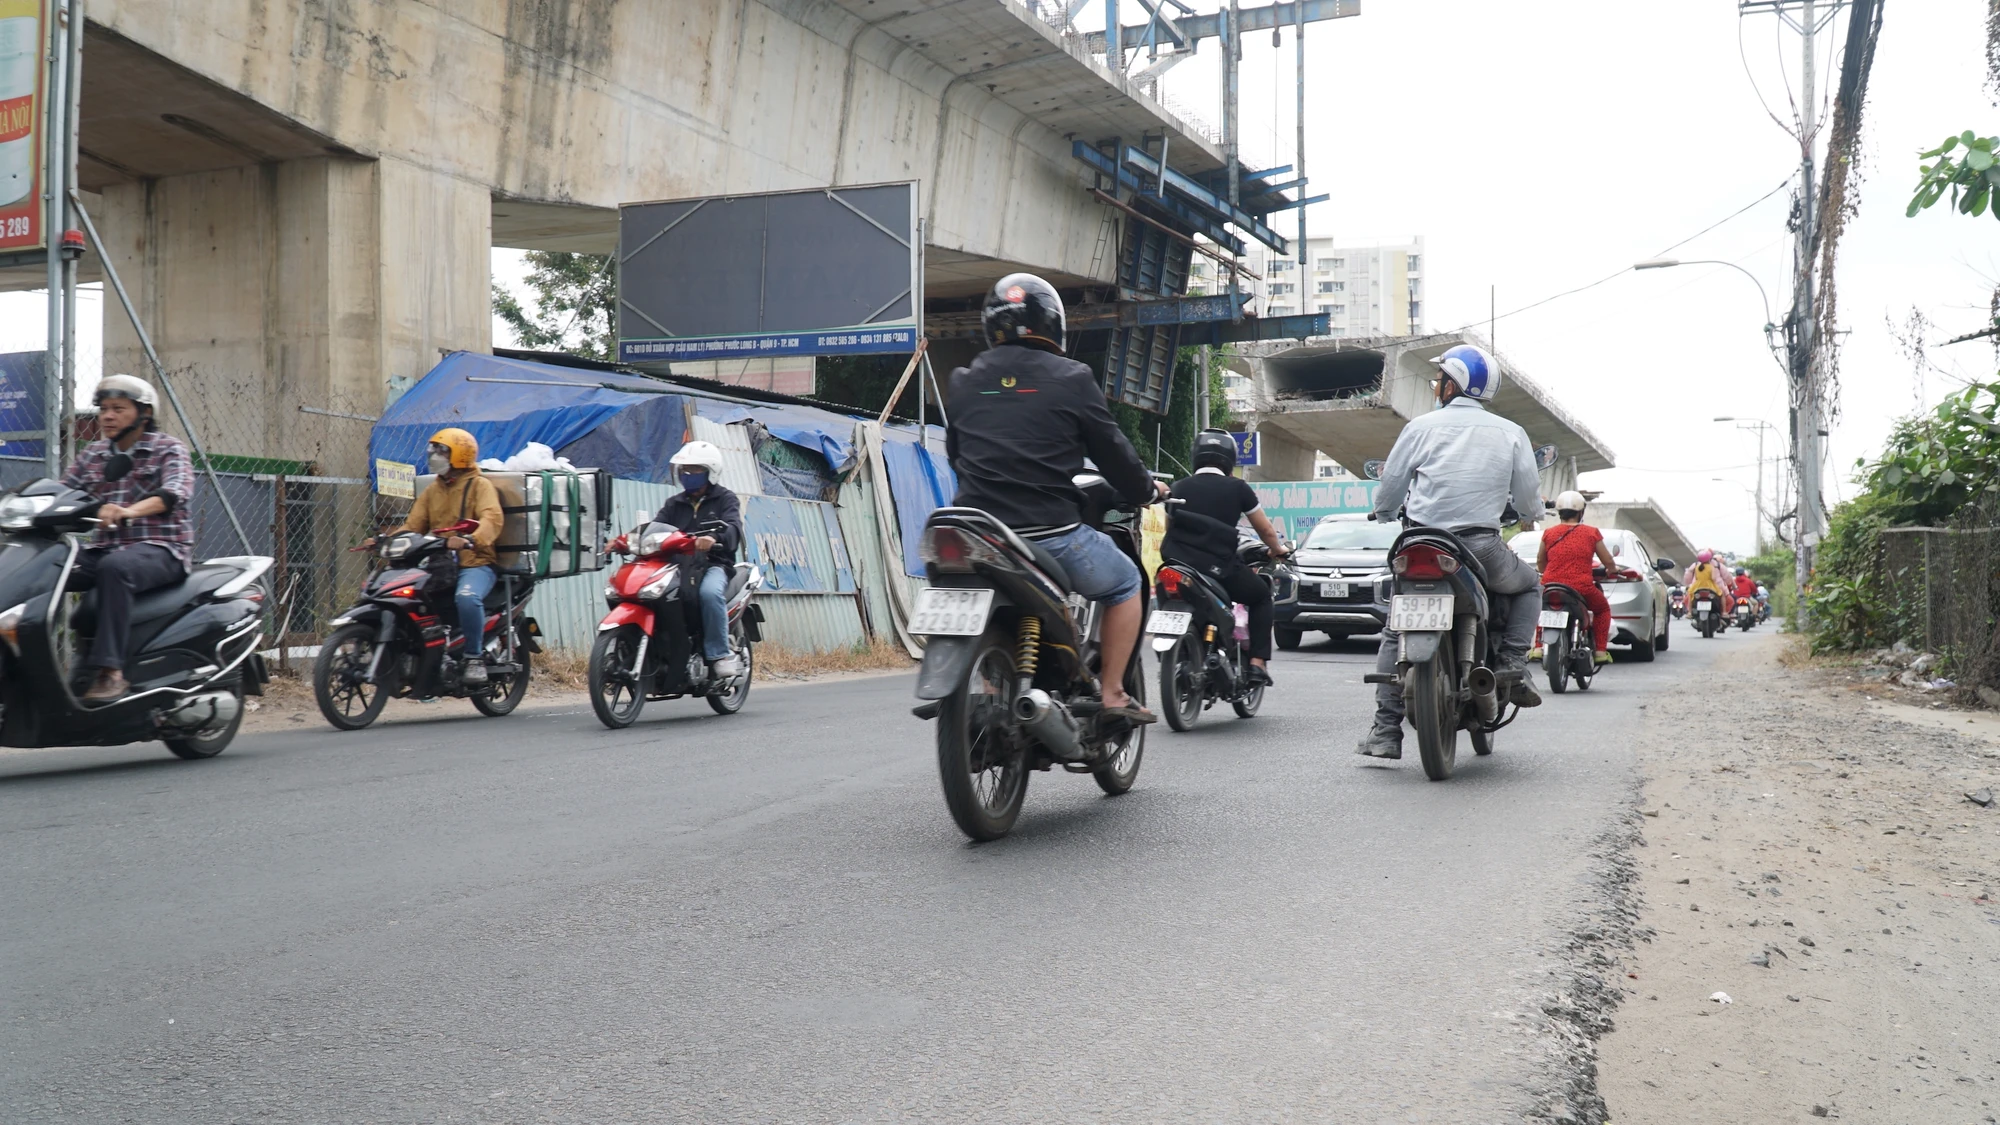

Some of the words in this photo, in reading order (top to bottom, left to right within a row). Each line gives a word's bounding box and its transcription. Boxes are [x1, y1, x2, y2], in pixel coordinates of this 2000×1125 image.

[11, 101, 31, 135] NỘI
[7, 216, 30, 238] 289
[740, 340, 752, 350] LONG
[787, 338, 799, 348] HCM
[1283, 483, 1308, 509] SẢN
[1310, 481, 1342, 508] XUẤT
[1344, 481, 1370, 508] CỦA
[1401, 598, 1443, 612] 59-P1
[1395, 613, 1448, 628] 167.84
